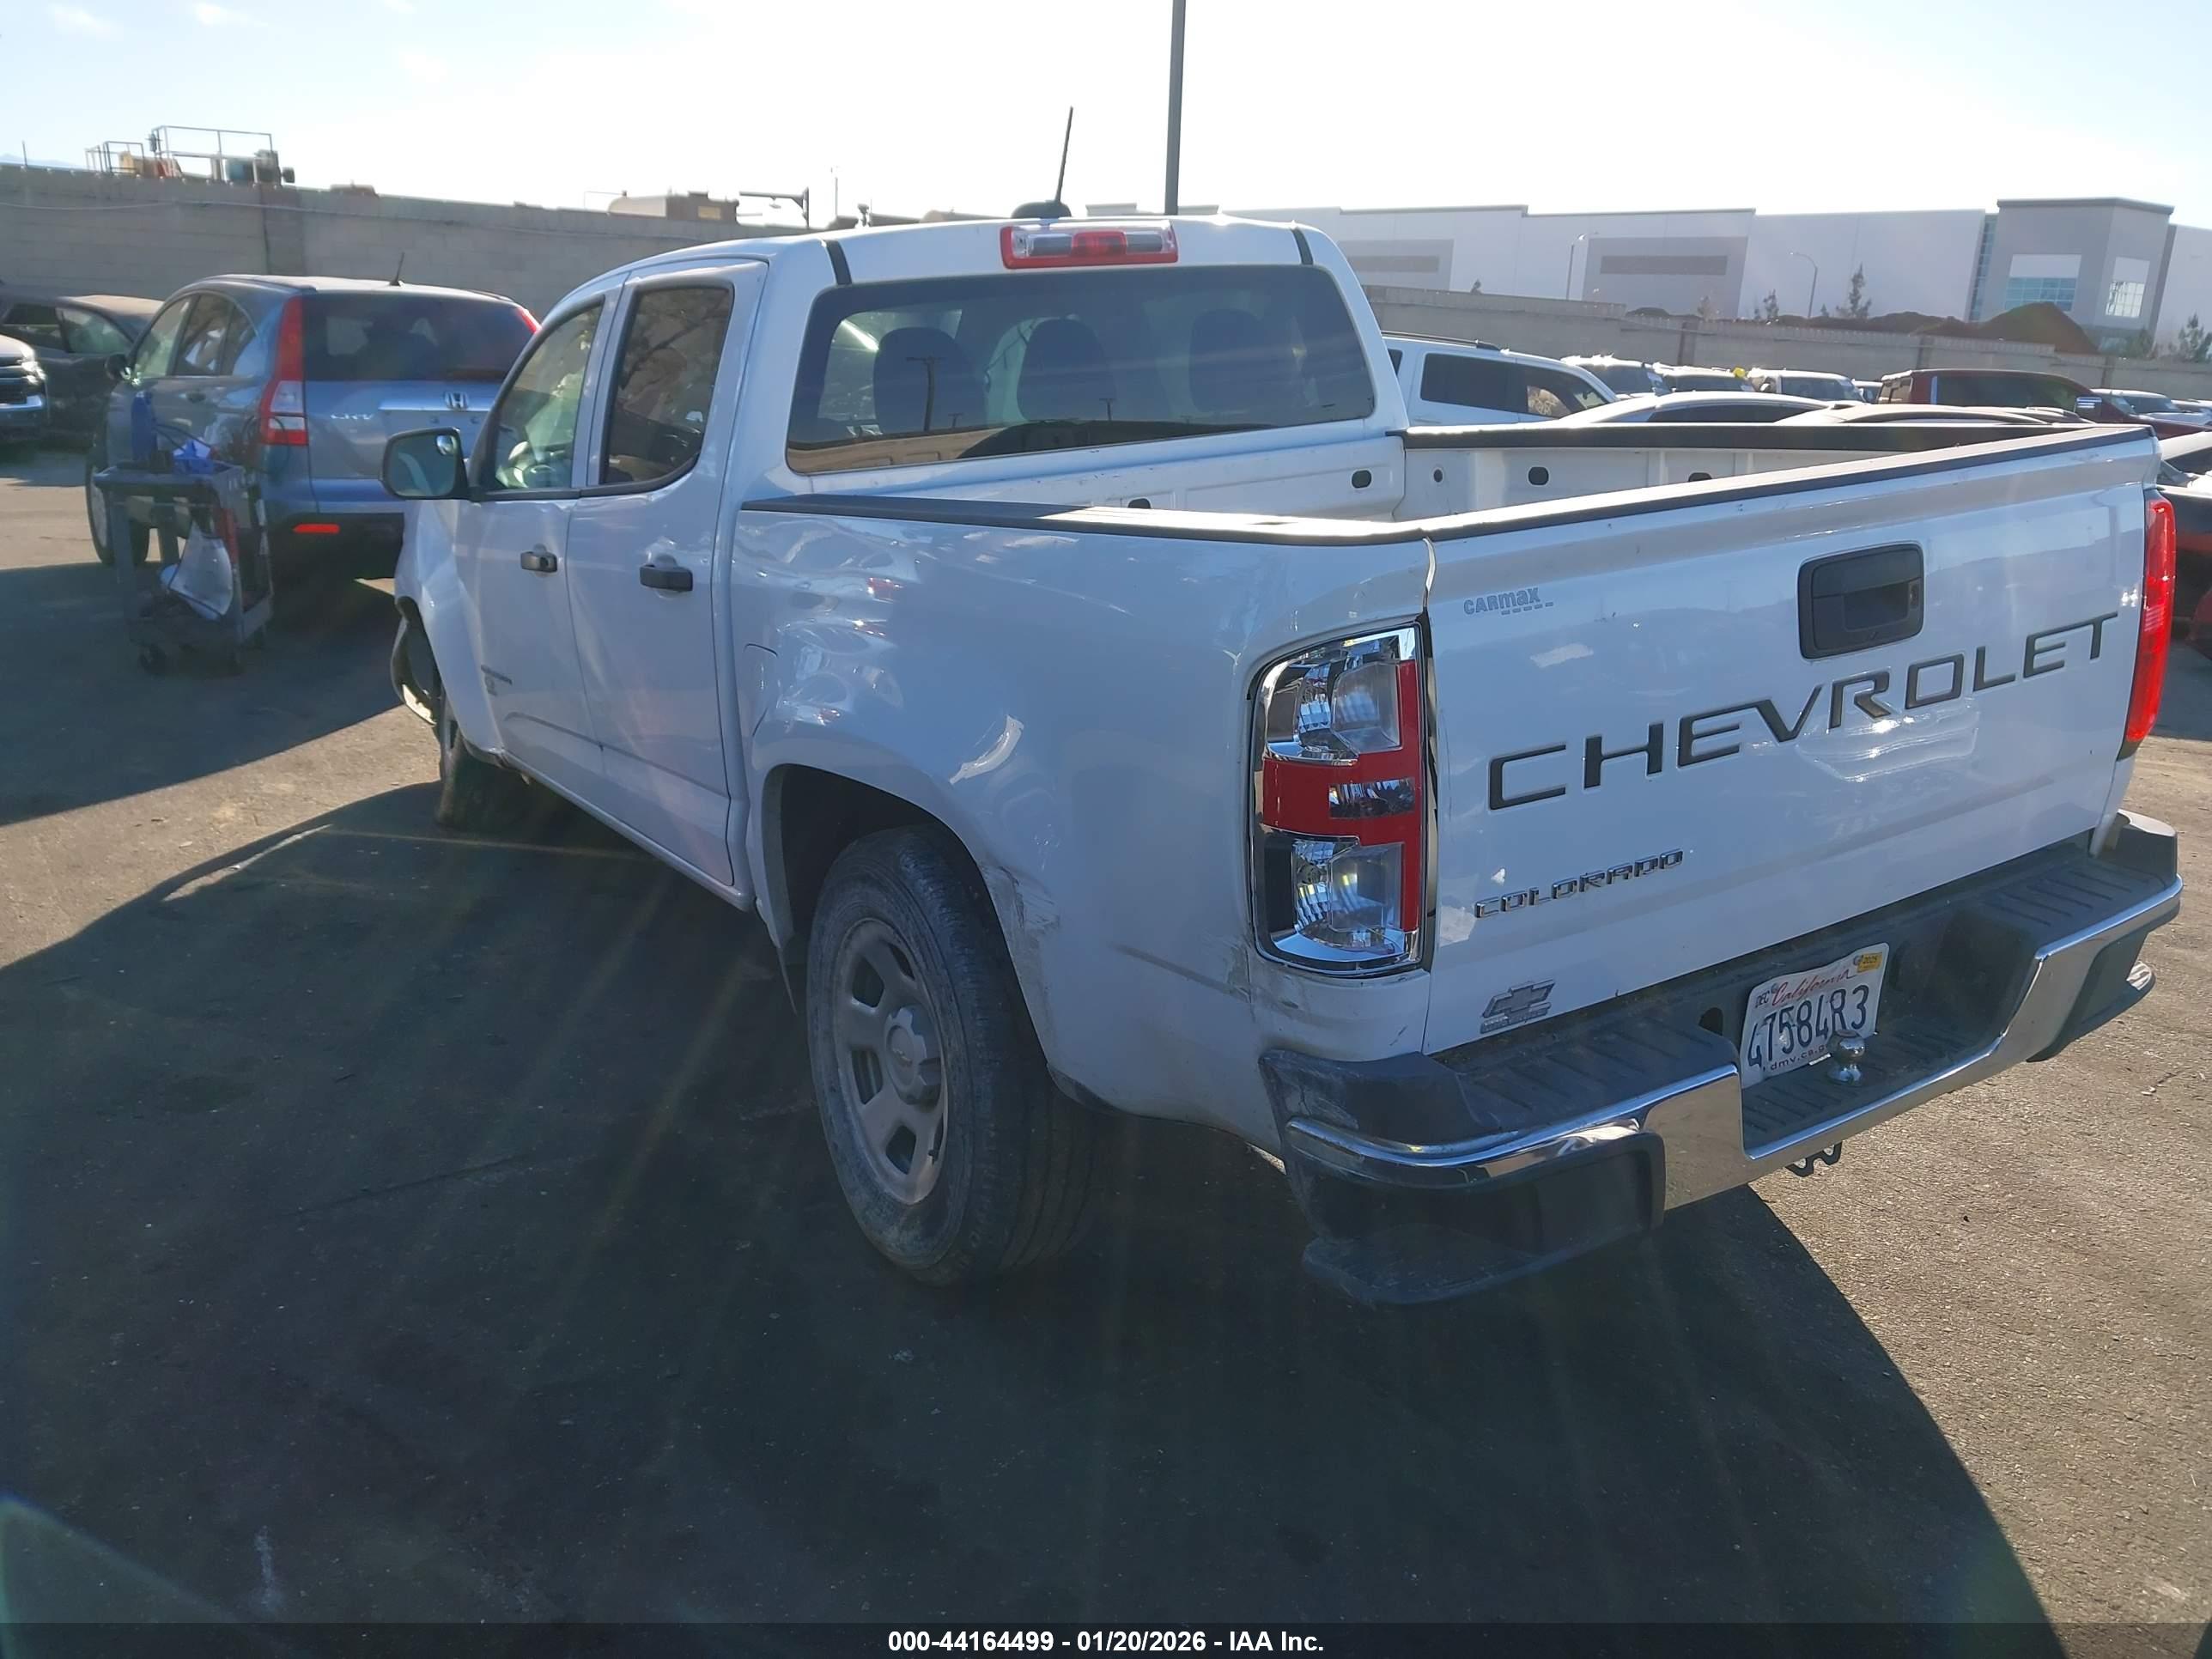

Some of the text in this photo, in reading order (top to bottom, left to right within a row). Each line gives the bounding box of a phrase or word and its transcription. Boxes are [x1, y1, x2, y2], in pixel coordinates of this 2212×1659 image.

[1488, 612, 2118, 811] CHEVROLET
[1474, 848, 1684, 919] COLORADO
[1771, 969, 1856, 1006] California
[1747, 985, 1869, 1068] 47584R3
[1770, 1044, 1827, 1072] dmv.ca.g
